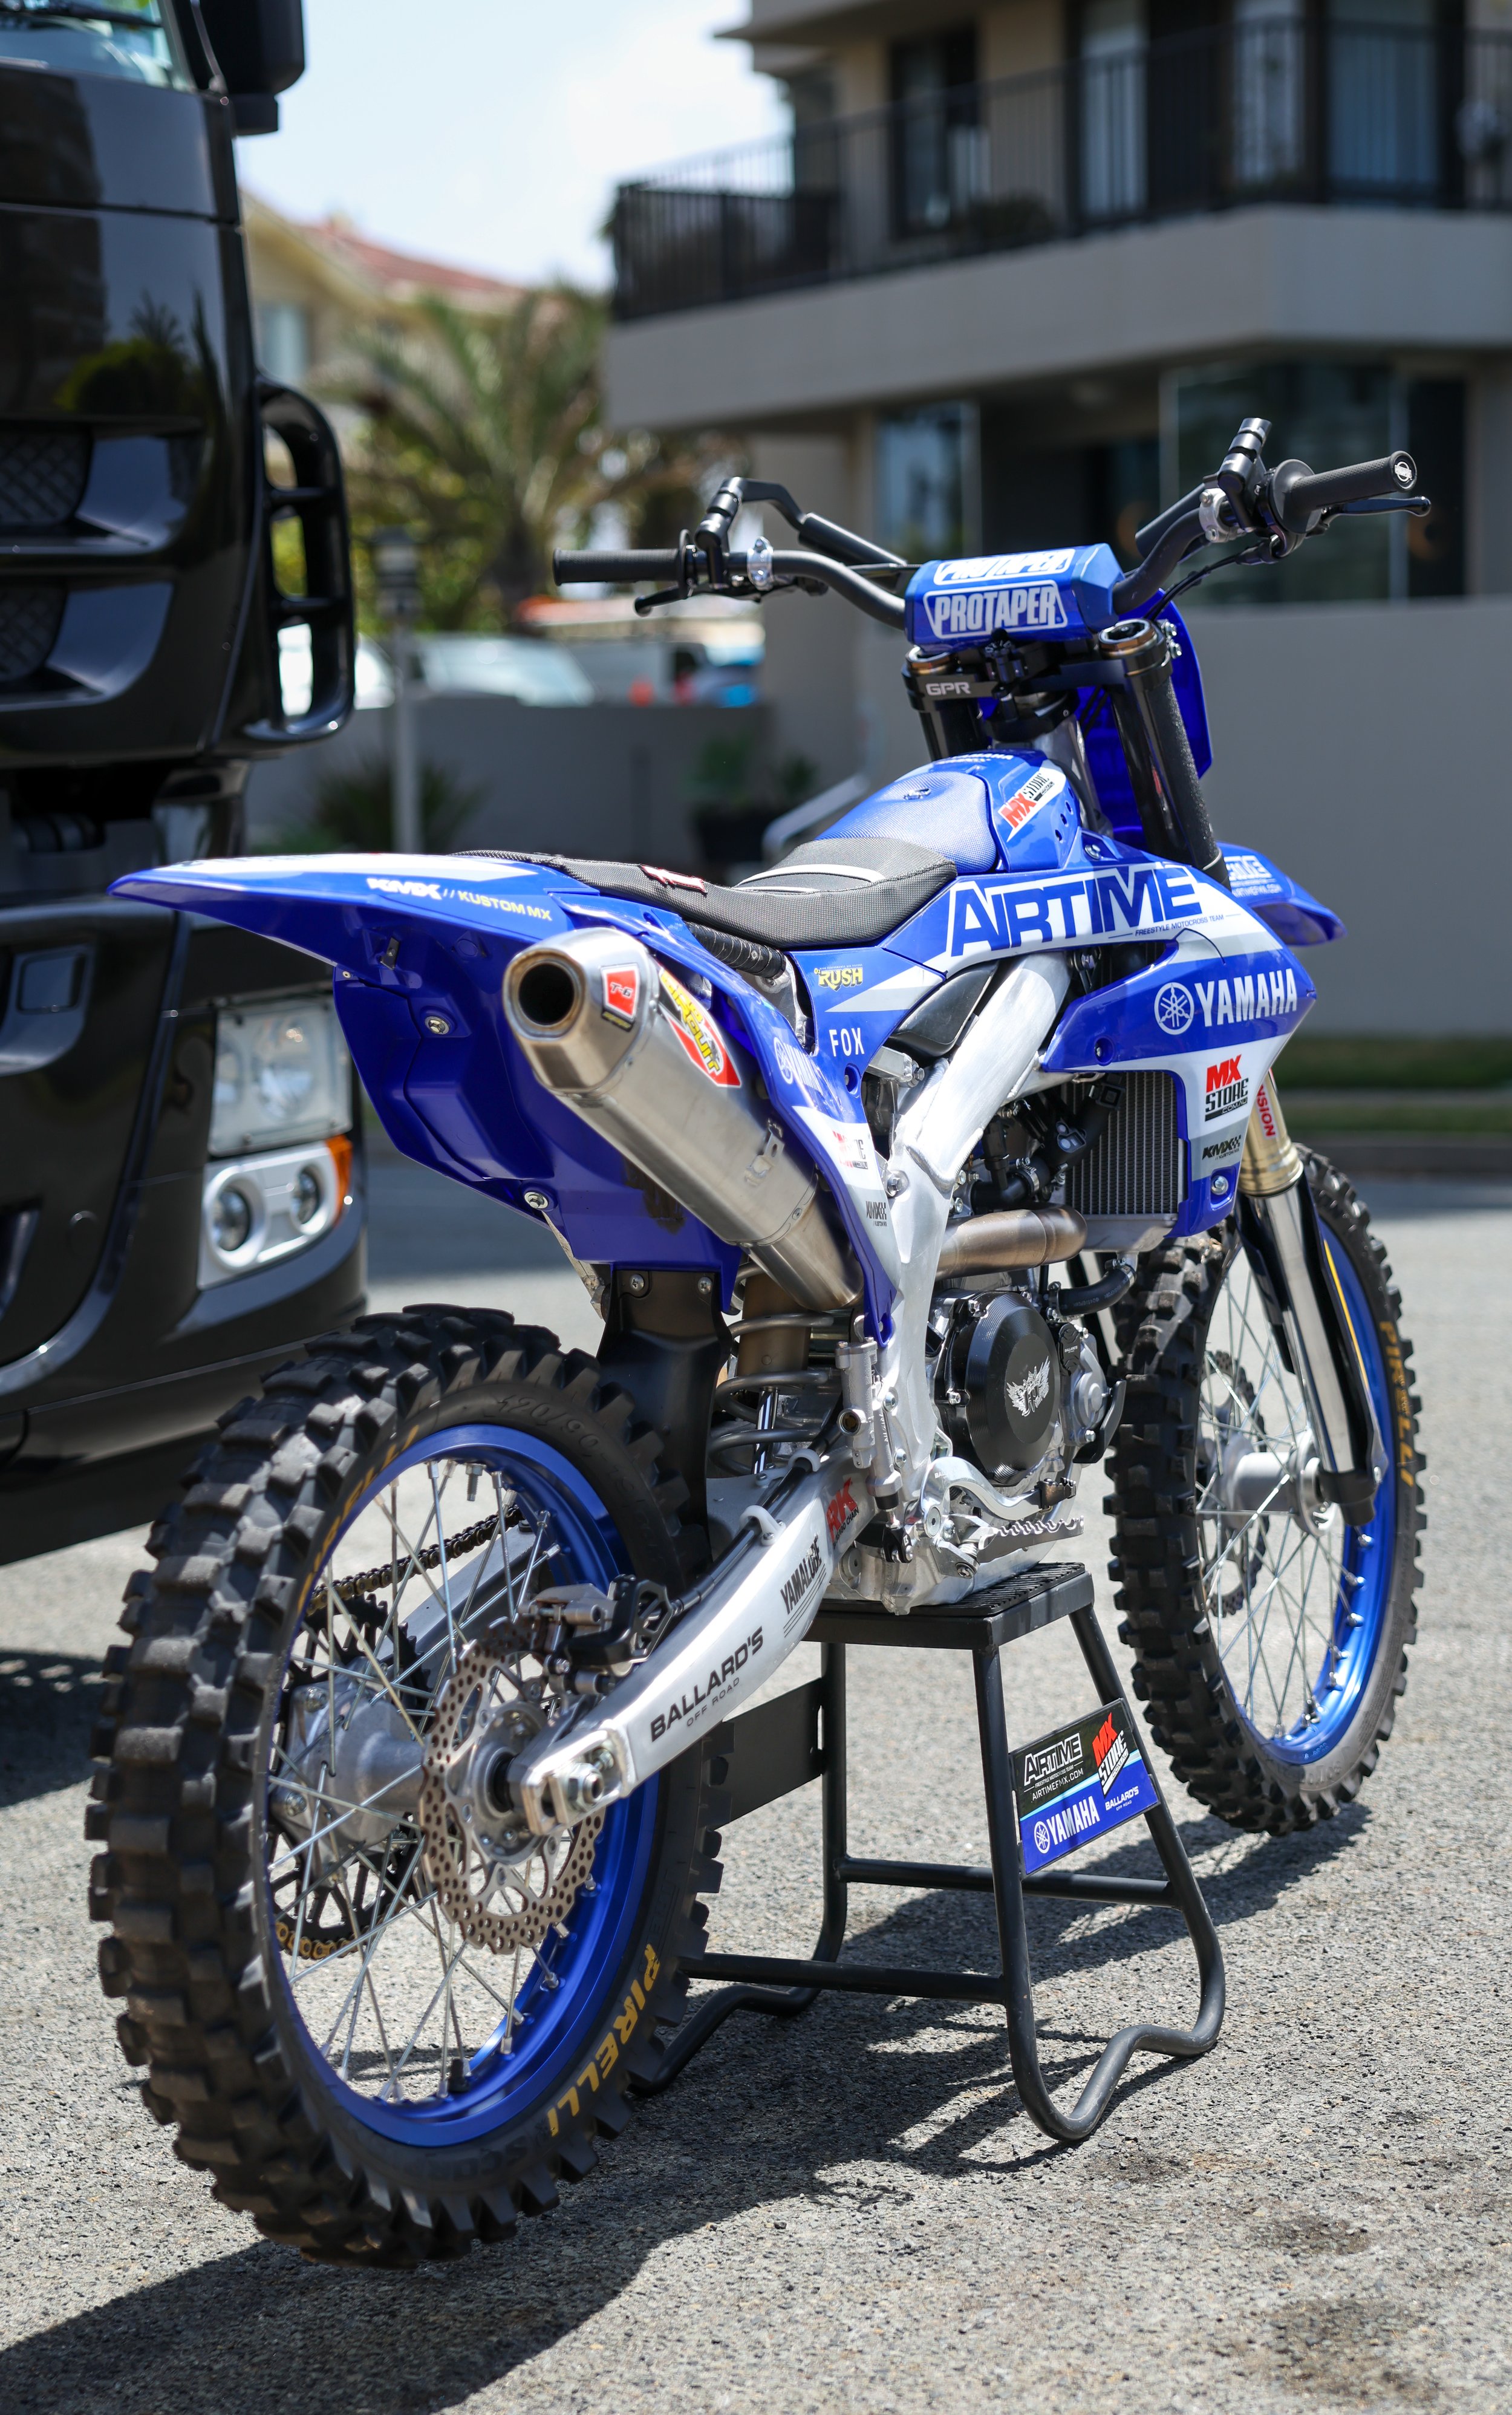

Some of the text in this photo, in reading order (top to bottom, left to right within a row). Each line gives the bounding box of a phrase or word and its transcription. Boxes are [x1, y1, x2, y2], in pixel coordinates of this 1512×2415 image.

[934, 585, 1057, 634] PROTAPER
[926, 682, 971, 696] GPR
[1000, 792, 1037, 829] MX
[458, 890, 526, 914] KUSTOM
[527, 905, 552, 921] MX
[1135, 914, 1225, 936] FREESTYLE MOTOCROSS TEAM
[610, 982, 633, 997] T-6
[818, 968, 863, 992] RUSH
[1194, 968, 1298, 1027] YAMAHA
[829, 1028, 865, 1057] FOX
[1206, 1054, 1242, 1093] MX
[1205, 1078, 1249, 1113] STORE
[1202, 1138, 1235, 1160] KMX
[1380, 1321, 1414, 1487] PIRELLI
[826, 1478, 858, 1543] RK
[846, 1507, 859, 1525] CHAIN
[650, 1626, 764, 1742] BALLARD'S
[686, 1677, 740, 1727] OFF ROAD
[1092, 1712, 1118, 1767] MX
[1032, 1767, 1084, 1801] AIRTIMEFMX.COM
[1035, 1764, 1074, 1788] FREESTYLE MOTOCROSS TEAM
[1105, 1785, 1139, 1811] BALLARD'S
[1046, 1796, 1101, 1845] YAMAHA
[547, 1943, 660, 2137] PIRELLI
